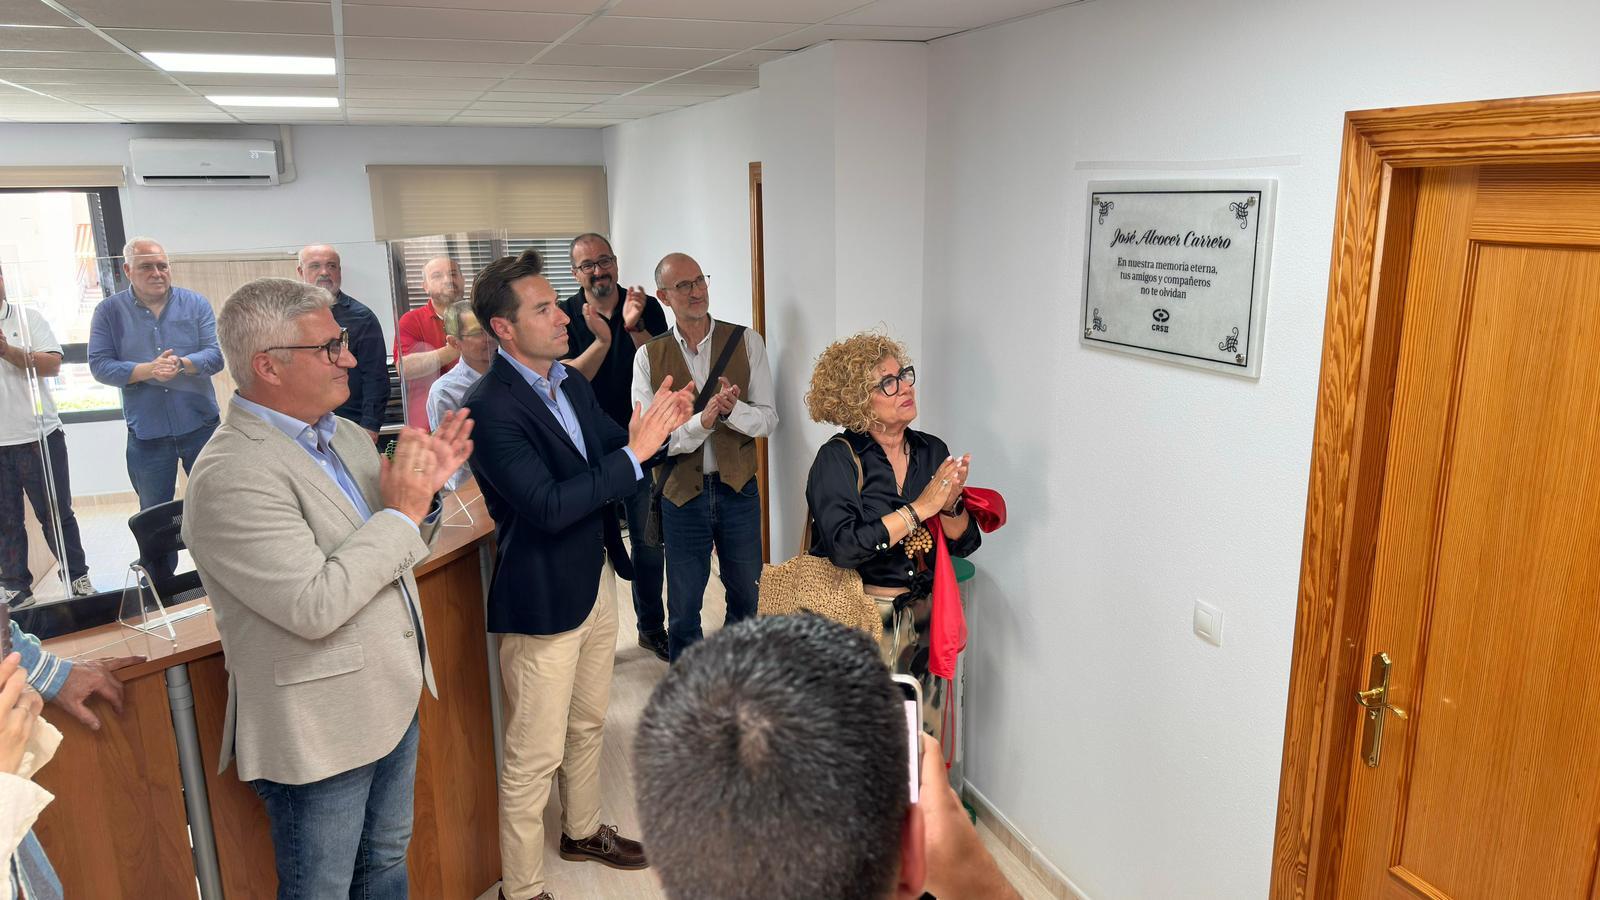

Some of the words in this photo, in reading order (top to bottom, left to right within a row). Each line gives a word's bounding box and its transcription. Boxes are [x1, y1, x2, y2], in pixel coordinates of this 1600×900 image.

[1110, 228, 1136, 248] José
[1136, 229, 1181, 247] Alcocer
[1184, 230, 1232, 249] Carrero
[1117, 257, 1127, 266] En
[1128, 258, 1155, 269] nuestra
[1155, 260, 1189, 272] memoria
[1190, 263, 1218, 275] eterna,
[1120, 271, 1131, 280] tus
[1132, 272, 1157, 284] amigos
[1157, 276, 1163, 285] y
[1163, 276, 1211, 288] compañeros
[1140, 286, 1150, 295] no
[1151, 287, 1158, 296] te
[1159, 287, 1187, 299] olvidan
